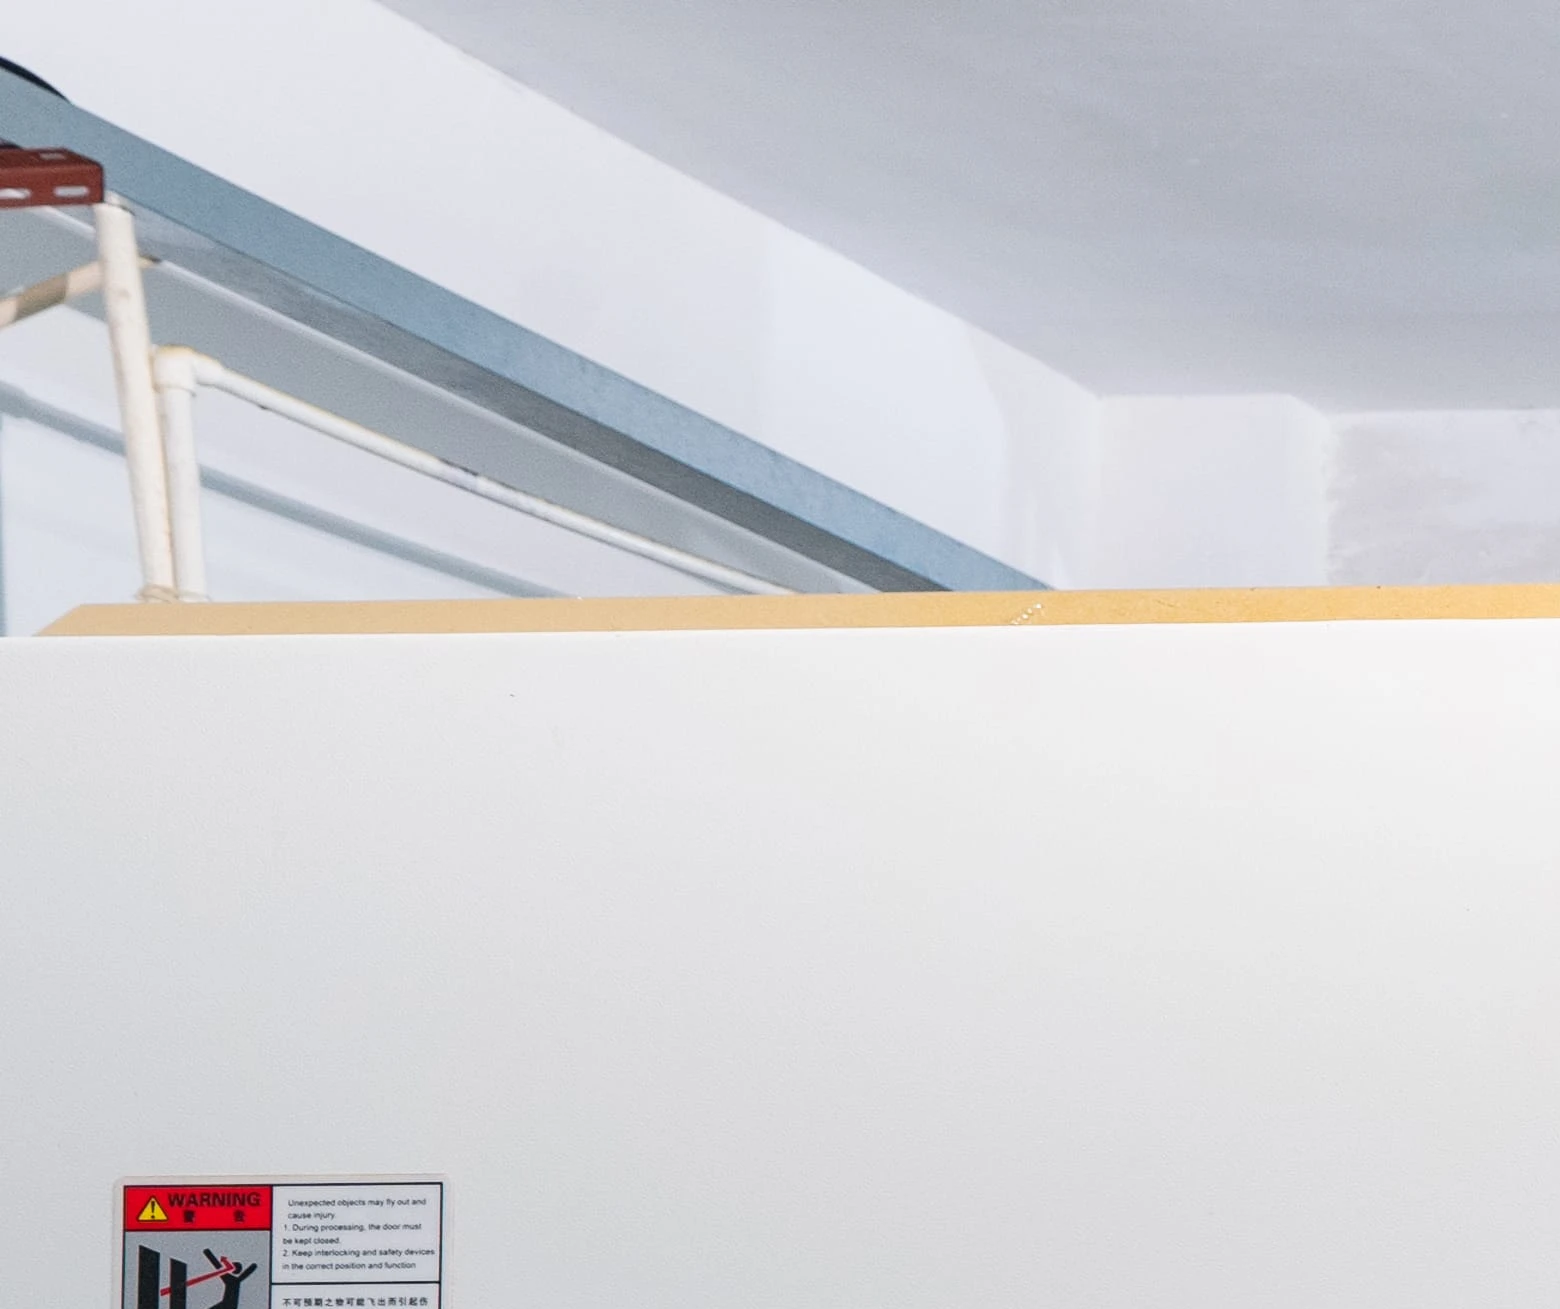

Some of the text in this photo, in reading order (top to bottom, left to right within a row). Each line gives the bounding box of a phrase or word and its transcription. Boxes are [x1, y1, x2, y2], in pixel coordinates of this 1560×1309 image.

[168, 1192, 260, 1207] WARNING
[288, 1199, 335, 1207] Unexpected
[338, 1199, 366, 1207] objects
[293, 1224, 318, 1232] During
[295, 1237, 312, 1245] kept
[292, 1250, 312, 1258] Keep
[315, 1249, 360, 1257] interlocking
[379, 1249, 402, 1257] safety
[306, 1262, 333, 1270] correct
[335, 1262, 366, 1270] position
[385, 1261, 416, 1269] function
